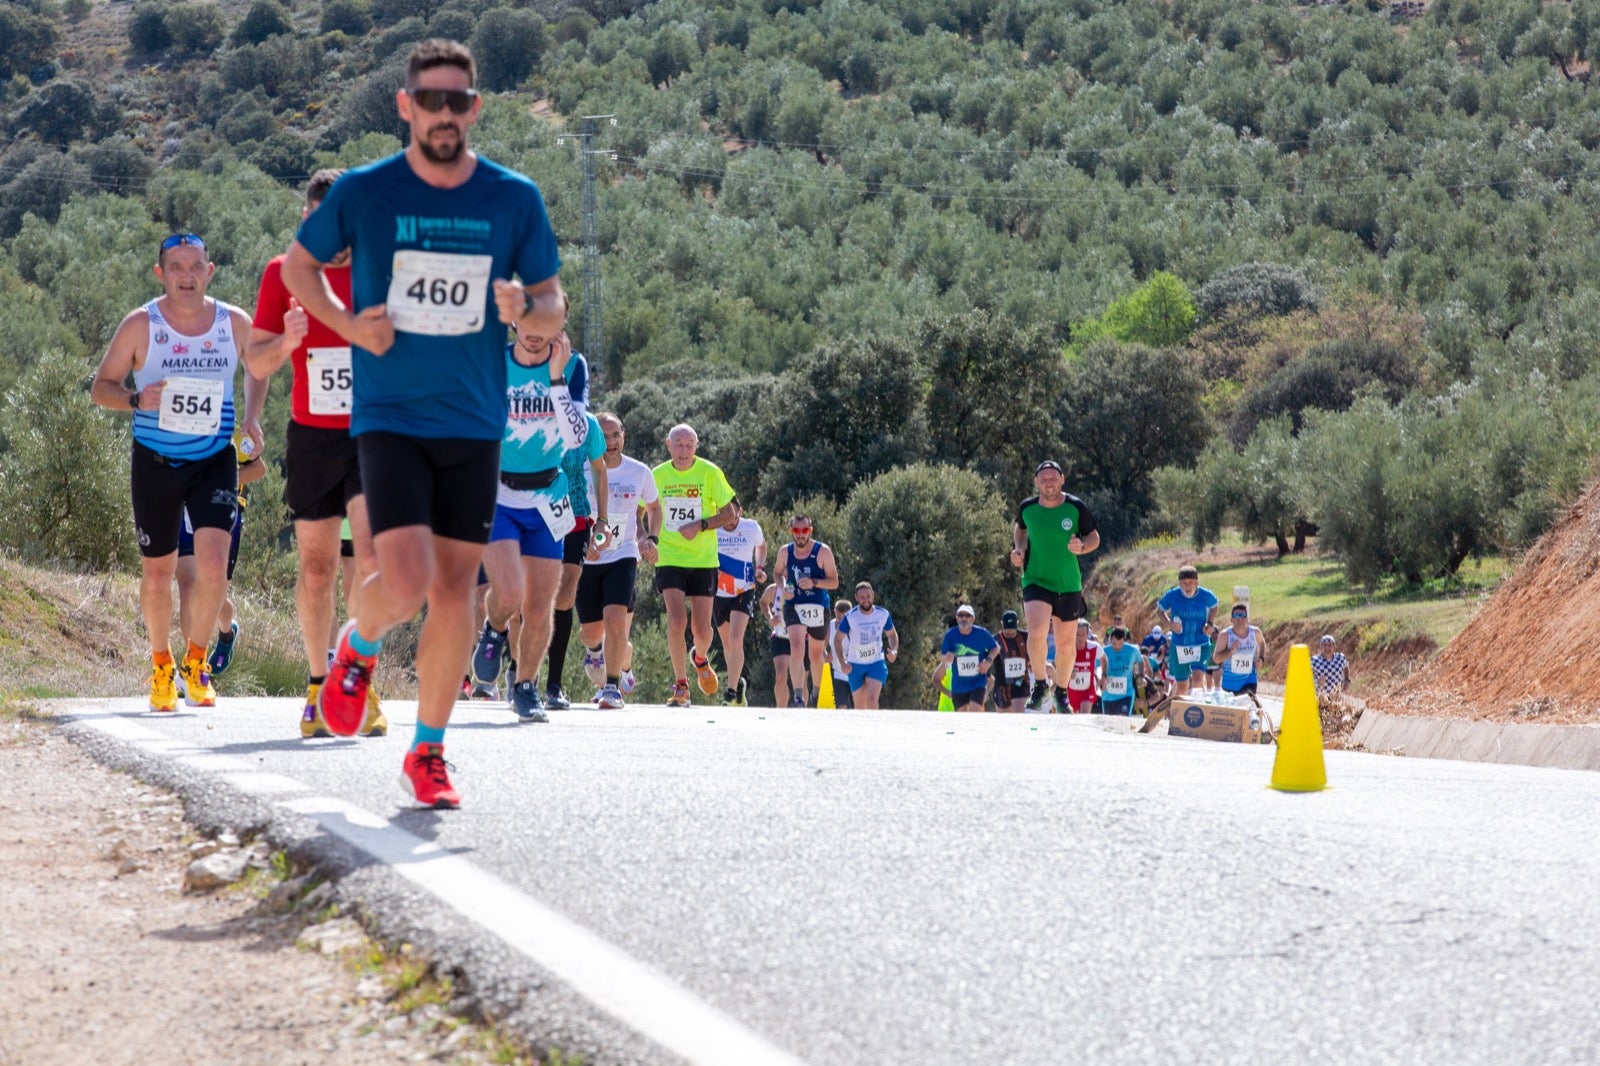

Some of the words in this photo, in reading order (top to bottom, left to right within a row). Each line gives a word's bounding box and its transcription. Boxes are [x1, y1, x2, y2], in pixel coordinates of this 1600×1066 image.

[396, 215, 417, 242] XI
[407, 277, 469, 307] 460
[161, 356, 229, 369] MARACENA
[321, 368, 353, 391] 55
[171, 394, 212, 416] 554
[669, 507, 696, 521] 754
[800, 609, 819, 619] 213
[1183, 647, 1194, 656] 96
[961, 662, 976, 671] 369
[1235, 659, 1250, 668] 738
[1075, 677, 1085, 685] 61
